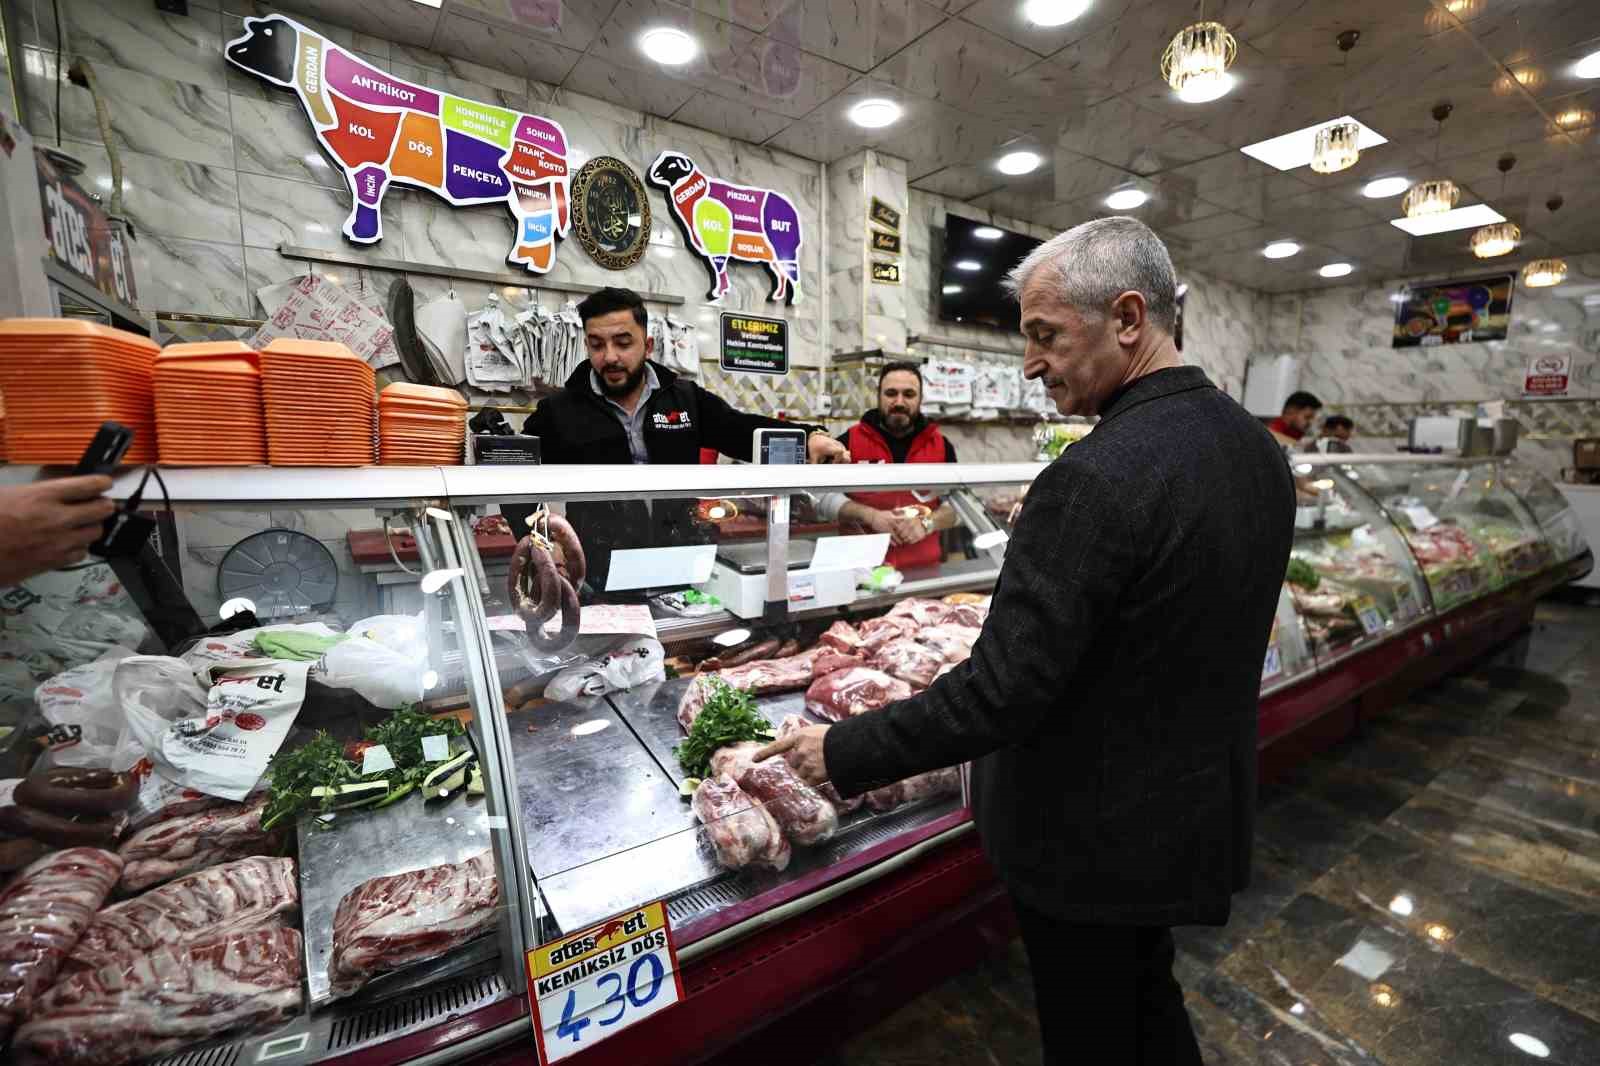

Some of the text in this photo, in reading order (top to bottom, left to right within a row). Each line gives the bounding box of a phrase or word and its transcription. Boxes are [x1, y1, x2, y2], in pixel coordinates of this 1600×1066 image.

[305, 47, 319, 94] GERDAN
[351, 74, 417, 104] ANTRİKOT
[349, 123, 376, 140] KOL
[526, 127, 556, 143] SOKUM
[408, 139, 433, 158] DÖŞ
[452, 164, 503, 187] PENÇETA
[771, 219, 792, 232] BUT
[257, 674, 286, 693] et
[624, 911, 648, 936] et
[537, 931, 666, 996] KEMİKSİZ DÖŞ
[556, 952, 665, 1042] 430
